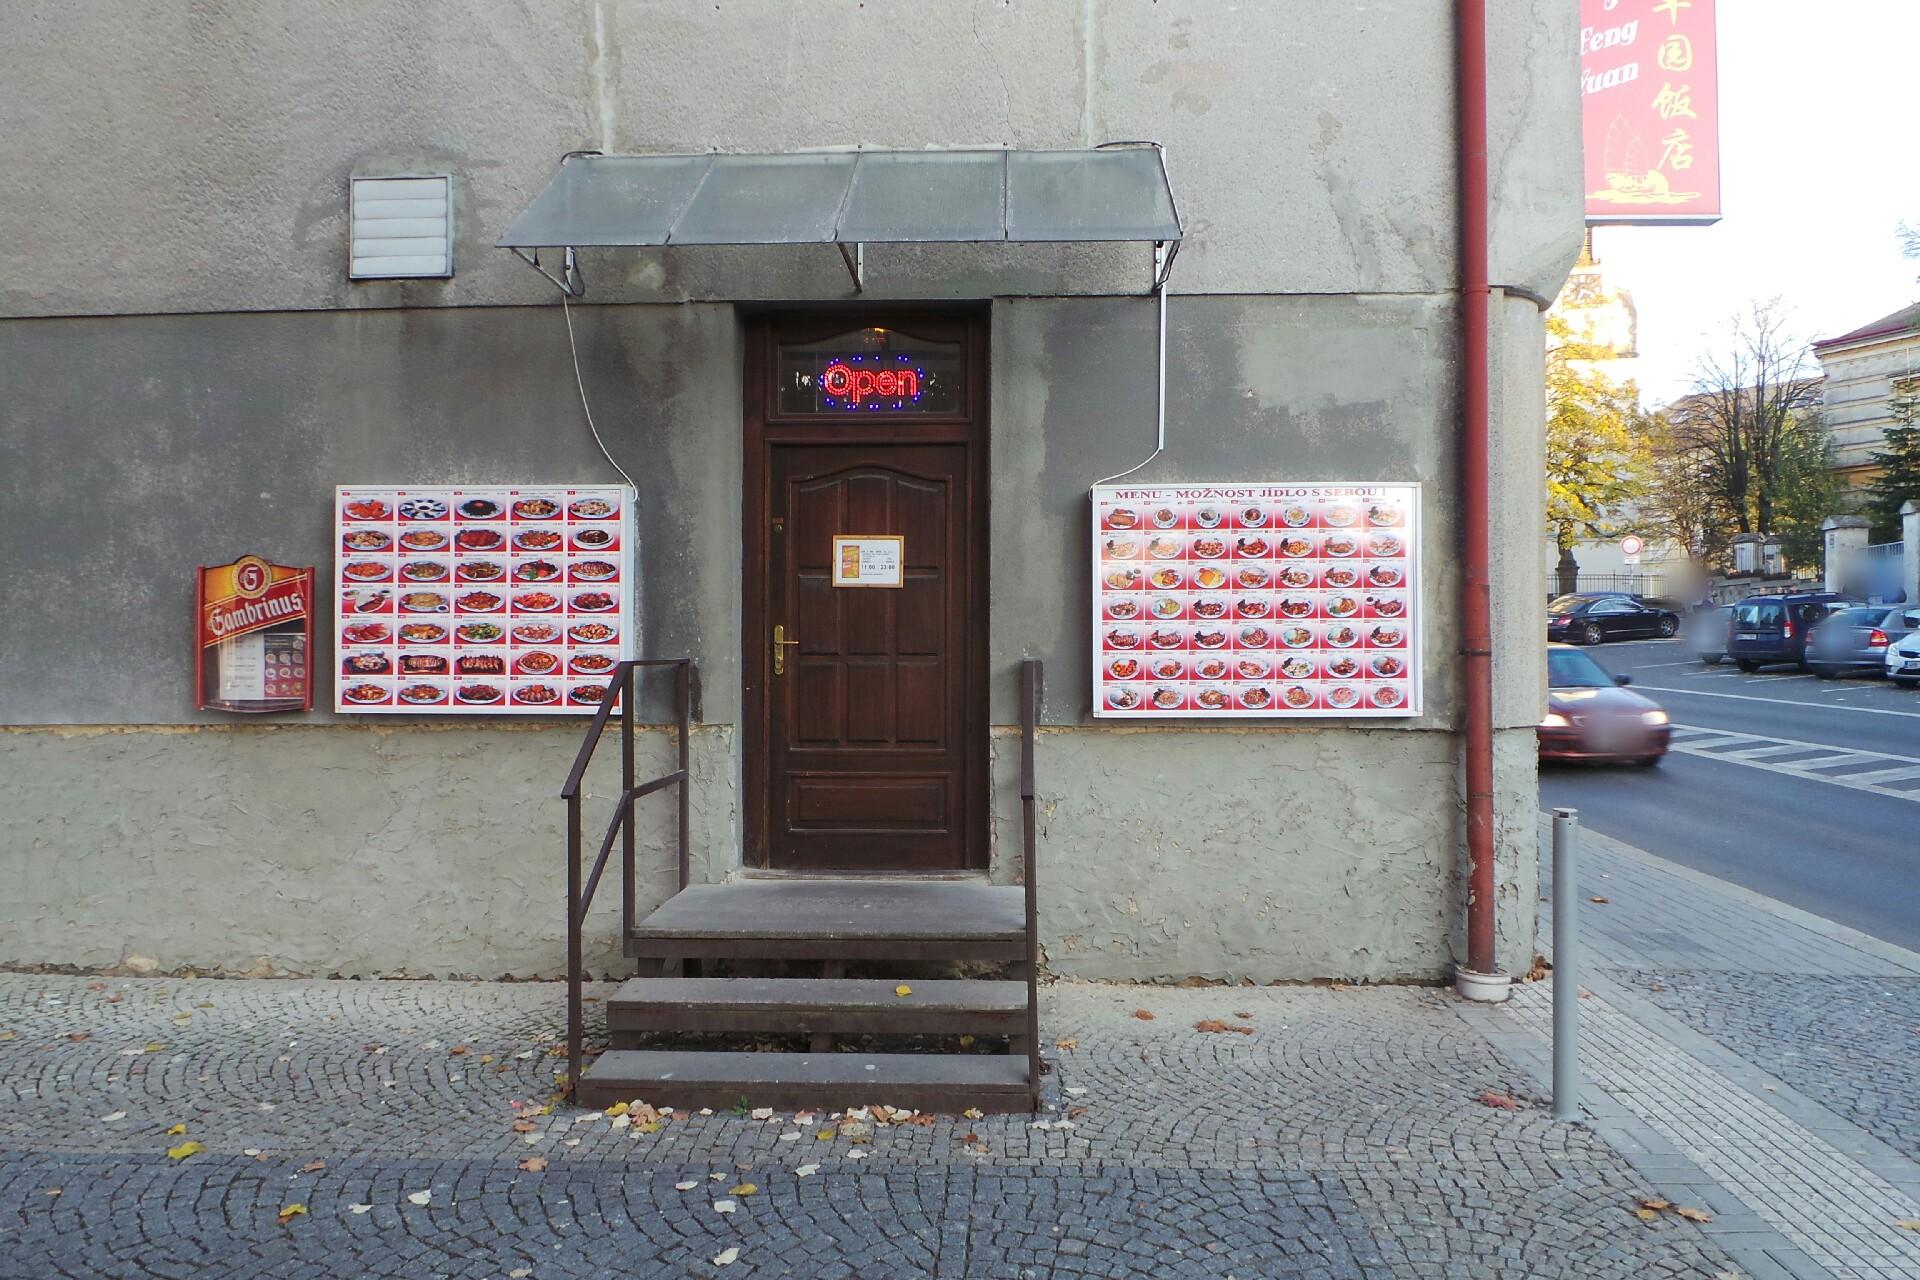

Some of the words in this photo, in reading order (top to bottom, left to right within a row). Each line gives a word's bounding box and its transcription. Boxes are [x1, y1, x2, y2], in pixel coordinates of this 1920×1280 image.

[1581, 19, 1640, 56] Feng
[824, 364, 918, 404] Open
[1115, 490, 1162, 499] MENU
[1175, 488, 1256, 499] MOŽNOST
[1259, 487, 1308, 498] JÍDLO
[1311, 488, 1320, 497] S
[1324, 487, 1377, 497] SEBOU
[208, 592, 304, 637] Gambrinus
